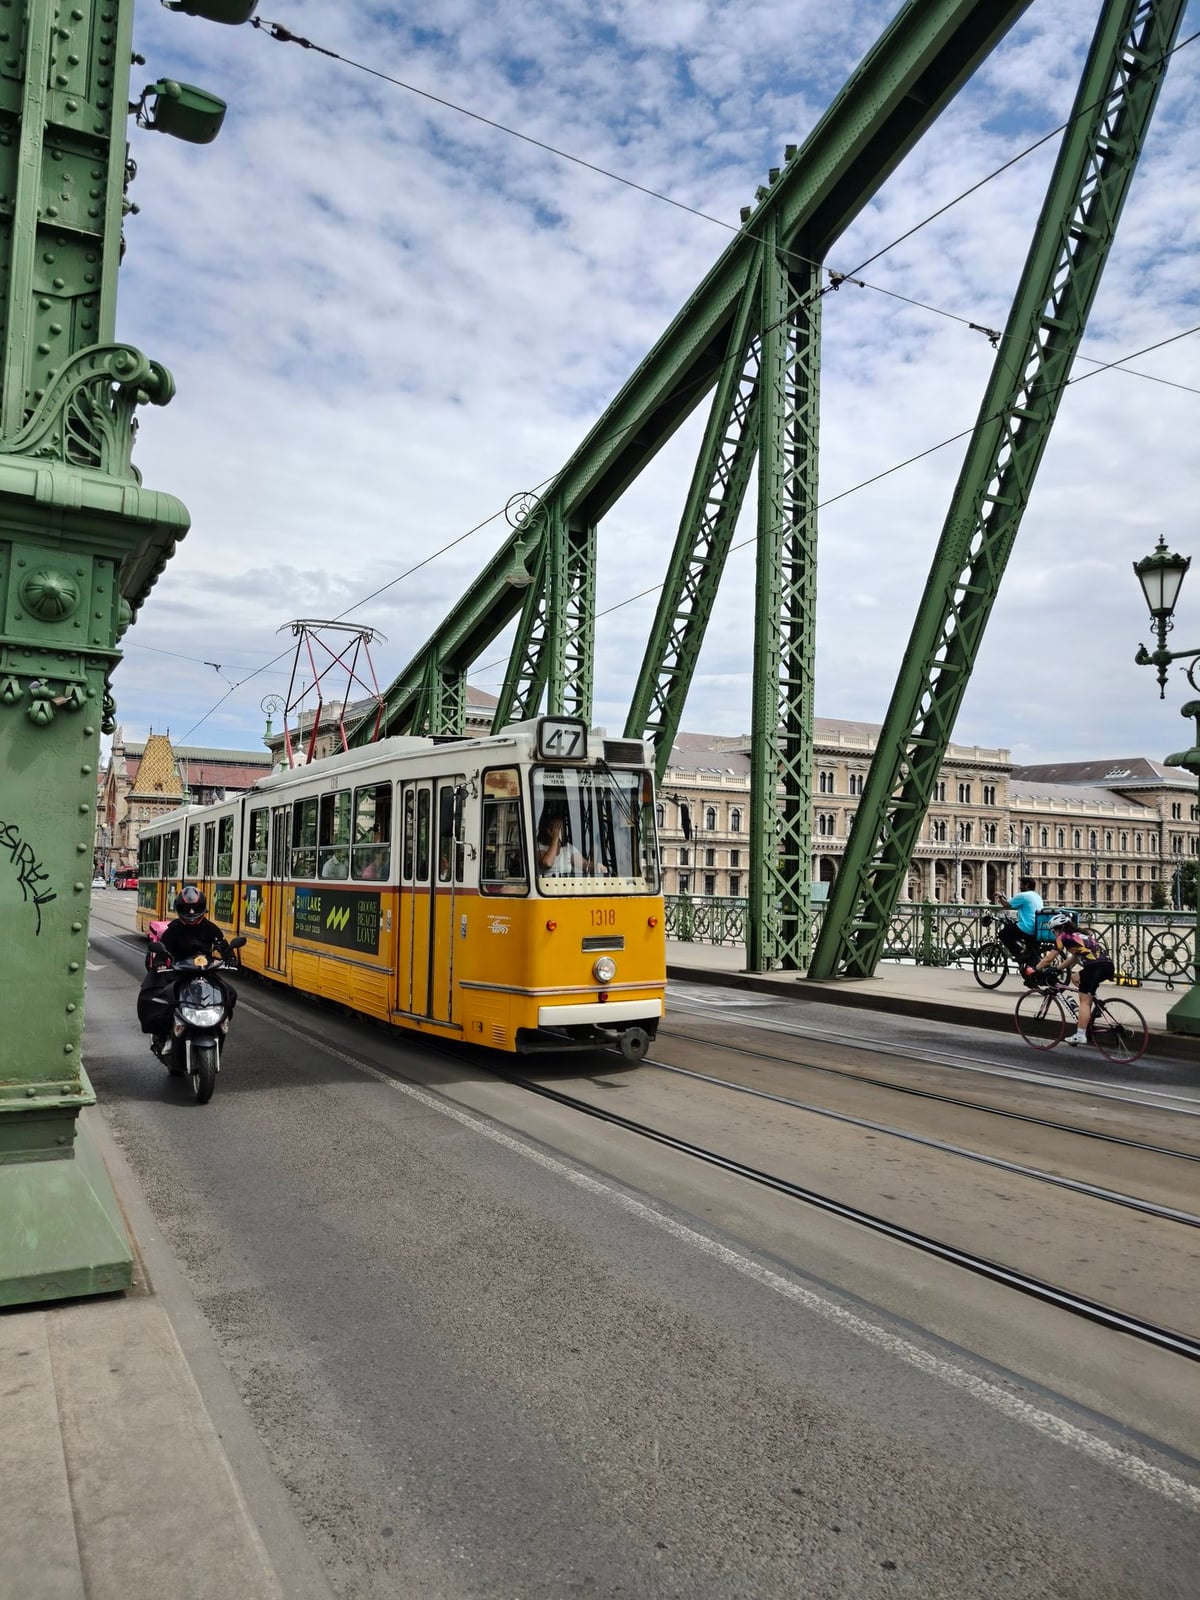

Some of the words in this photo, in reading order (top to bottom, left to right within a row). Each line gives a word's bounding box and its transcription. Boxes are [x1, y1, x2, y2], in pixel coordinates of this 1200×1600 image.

[545, 729, 581, 756] 47
[357, 913, 377, 928] BEACH
[590, 909, 616, 927] 1318
[356, 927, 377, 945] LOVE
